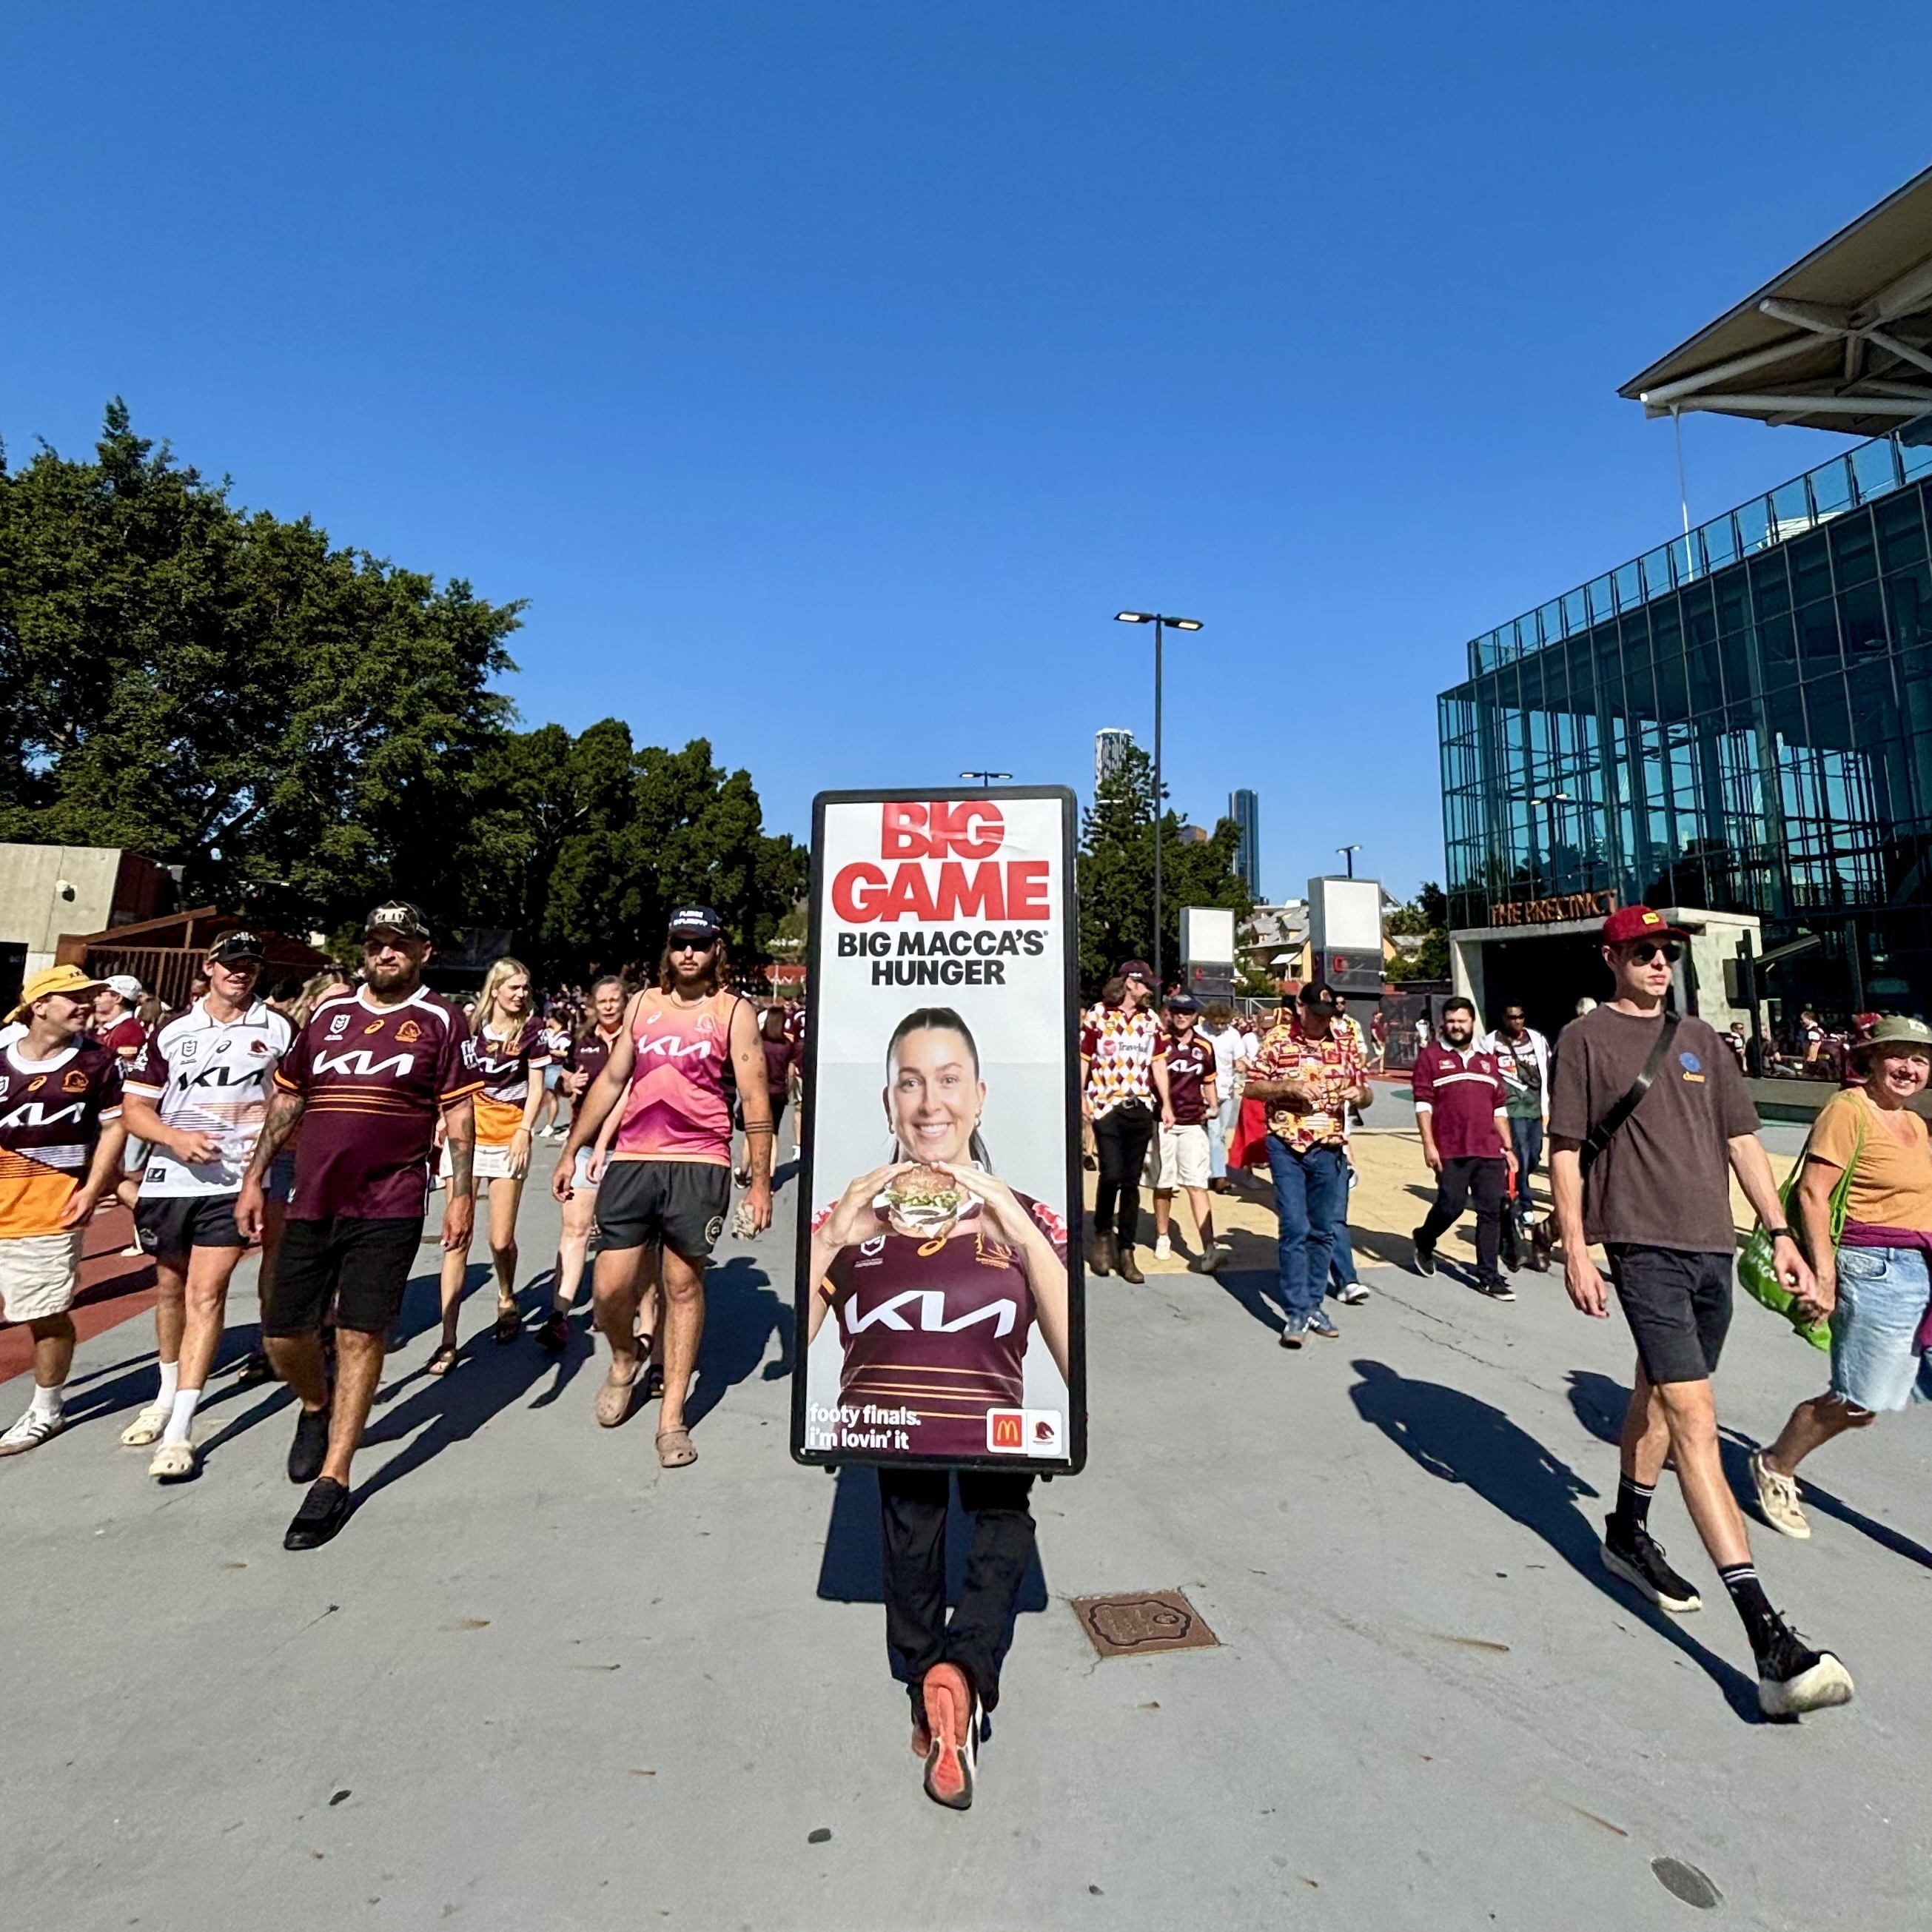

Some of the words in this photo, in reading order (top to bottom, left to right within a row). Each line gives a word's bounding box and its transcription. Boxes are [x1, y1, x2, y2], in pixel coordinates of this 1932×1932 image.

[881, 801, 1005, 859] BIG
[831, 861, 1050, 924] GAME
[1490, 902, 1522, 926] THE
[837, 931, 891, 957] BIG
[871, 959, 1006, 986] HUNGER
[810, 1403, 860, 1429] footy
[863, 1405, 922, 1426] finals.
[809, 1426, 838, 1446] i’m
[841, 1429, 892, 1449] lovin’
[894, 1429, 910, 1450] it
